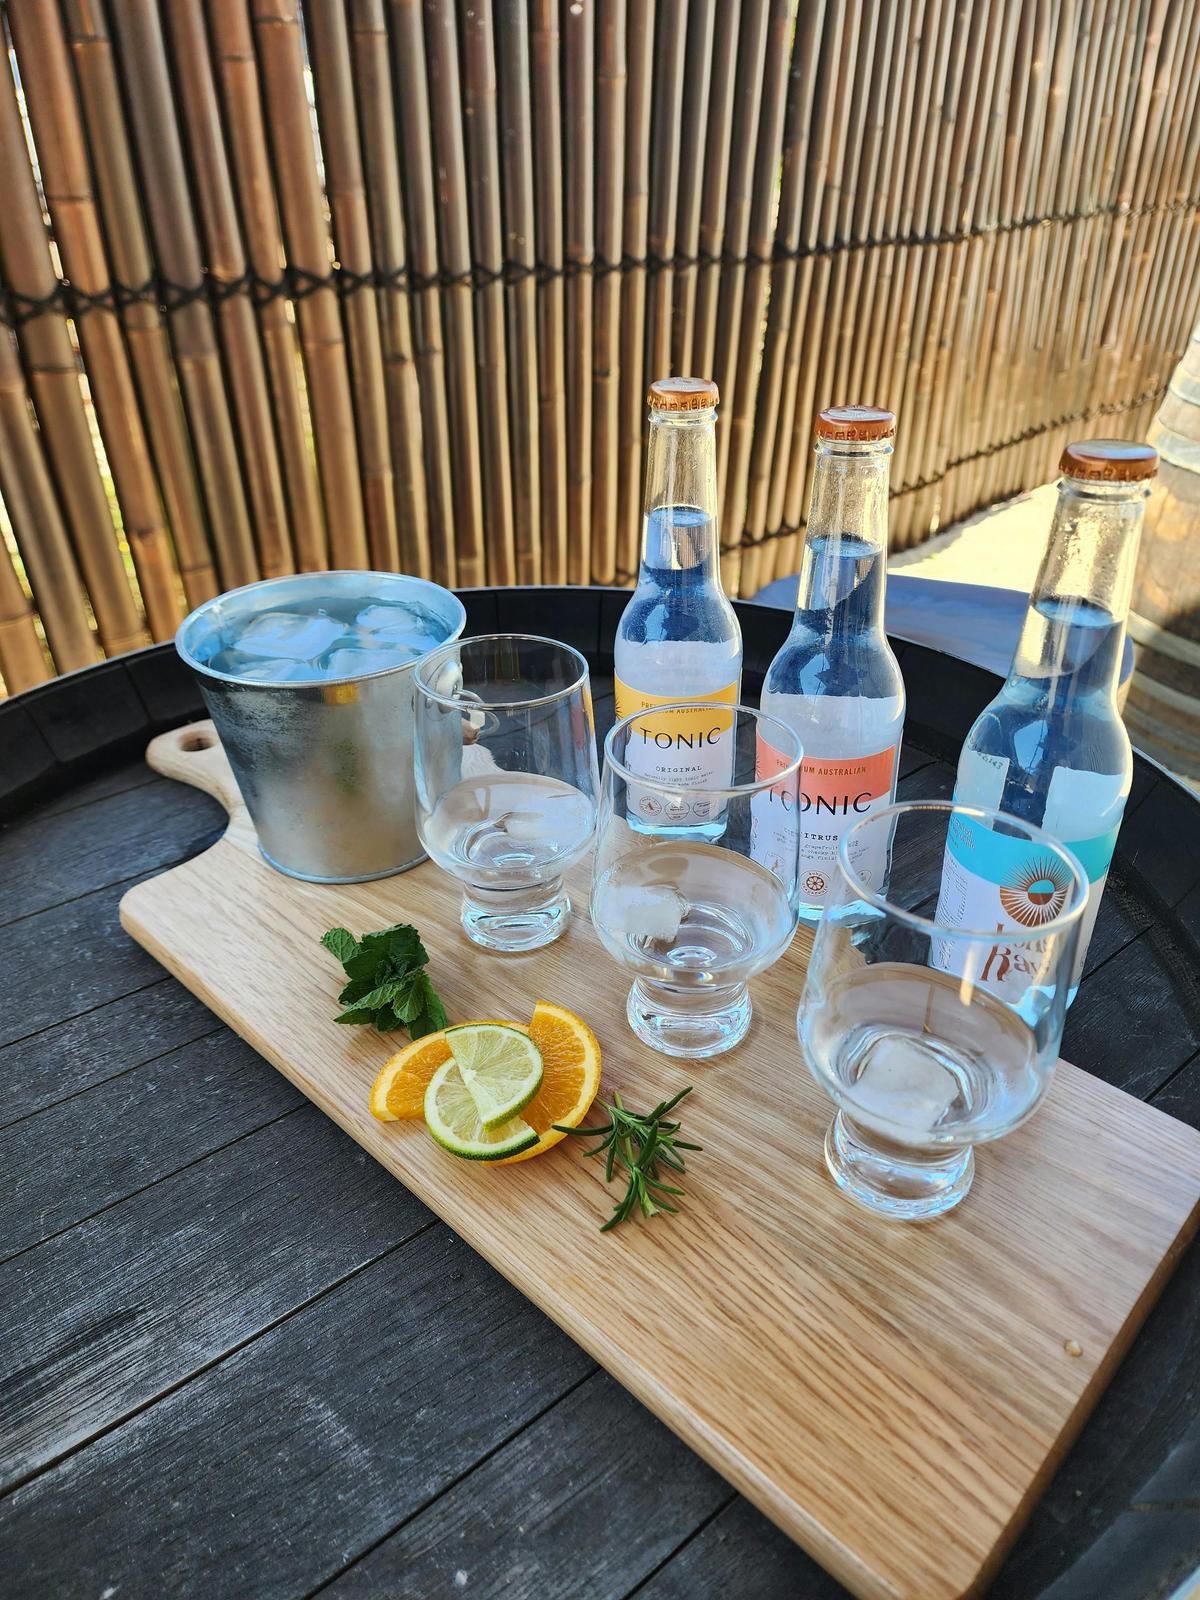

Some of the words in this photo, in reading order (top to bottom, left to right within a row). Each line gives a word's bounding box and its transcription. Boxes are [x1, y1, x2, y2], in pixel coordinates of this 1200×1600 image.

[641, 701, 674, 714] PREUM
[640, 727, 721, 750] TONIC
[656, 765, 703, 773] ORIGINAL
[776, 759, 815, 775] PREUM
[818, 766, 866, 776] AUSTRALIAN
[800, 831, 839, 841] ITRUS
[979, 943, 1051, 982] Ray
